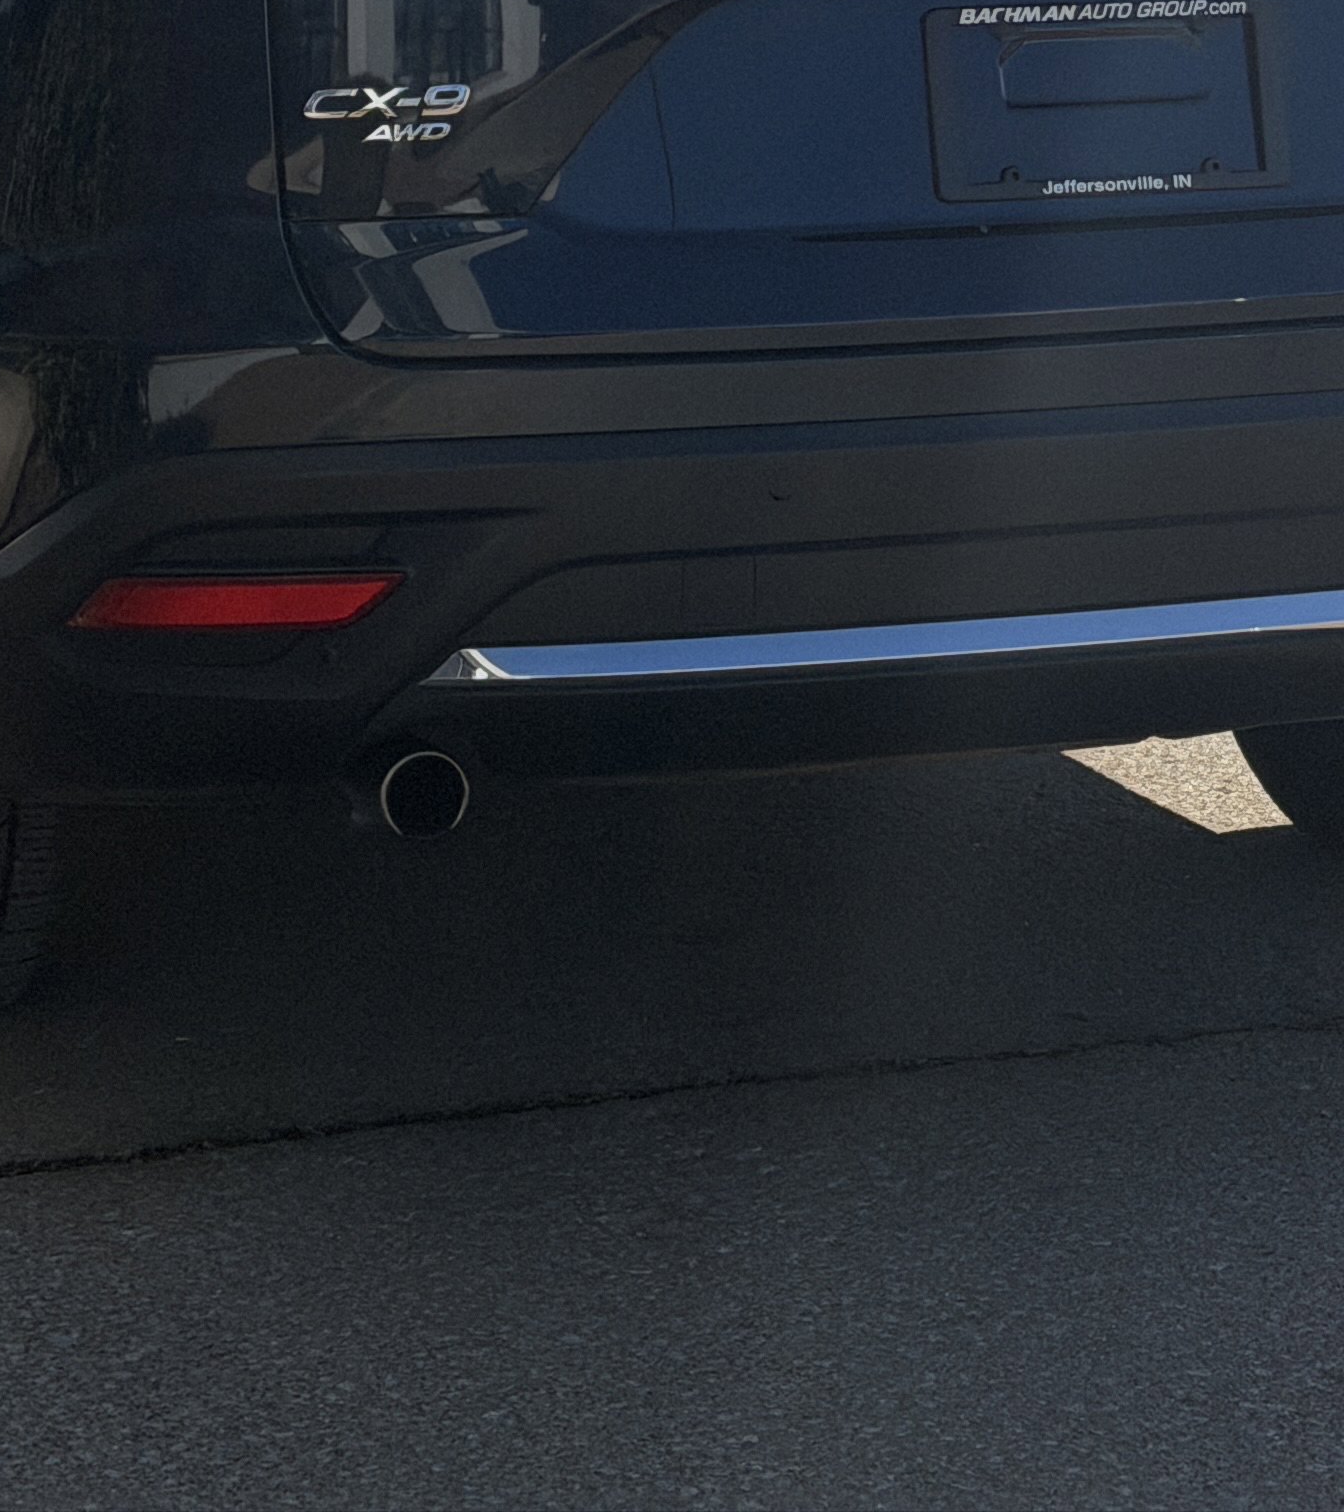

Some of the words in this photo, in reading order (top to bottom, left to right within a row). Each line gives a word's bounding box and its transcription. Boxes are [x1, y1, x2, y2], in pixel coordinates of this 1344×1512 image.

[959, 5, 1076, 25] BACHMAN
[1077, 2, 1133, 20] AUTO
[1136, 0, 1247, 18] GROUP.com
[303, 83, 471, 119] CX-9
[361, 122, 451, 142] AWD
[1042, 175, 1169, 195] Jeffersonville,
[1173, 173, 1193, 188] IN
